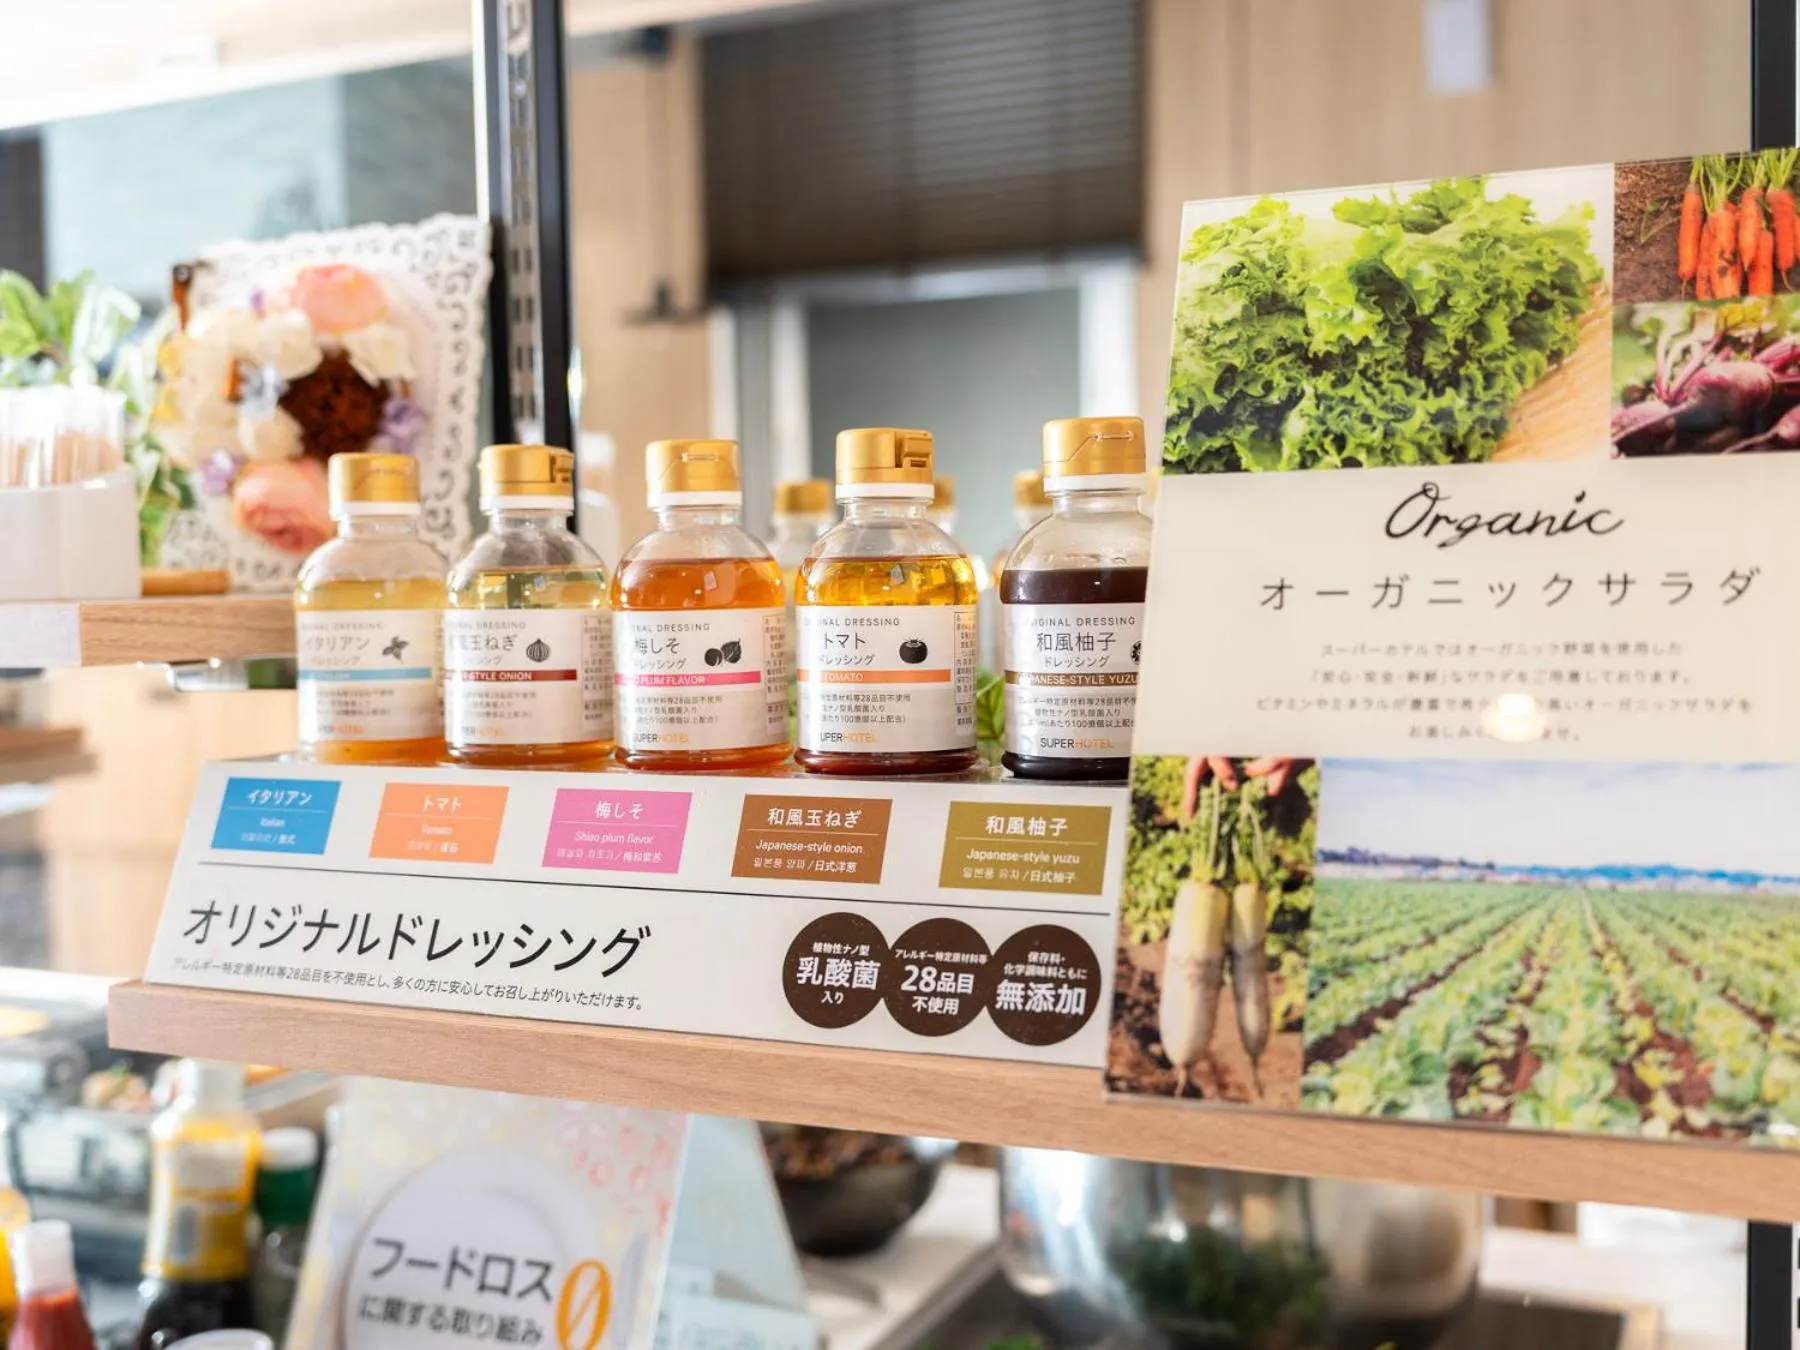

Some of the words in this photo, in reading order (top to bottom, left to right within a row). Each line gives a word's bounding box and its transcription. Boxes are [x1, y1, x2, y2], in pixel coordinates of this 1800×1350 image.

[1384, 482, 1625, 548] Organic
[1260, 566, 1761, 610] オーガニックサラダ
[657, 623, 710, 633] DRESSING
[845, 618, 900, 627] DRESSING
[1076, 616, 1136, 627] DRESSING
[635, 638, 680, 655] 梅しそ
[824, 632, 866, 650] トマト
[1037, 631, 1117, 652] 和風柚子
[1045, 655, 1110, 668] ドレッシング
[499, 671, 533, 681] ONION
[666, 675, 706, 686] FLAVOR
[824, 672, 864, 682] TOMATO
[820, 732, 875, 743] UPERHOTEL
[1040, 737, 1113, 749] SUPERHOTEL
[247, 788, 313, 806] イタリアン
[422, 795, 462, 812] トマト
[595, 800, 643, 819] 梅しそ
[767, 808, 862, 829] 和風玉ねぎ
[985, 815, 1068, 837] 和風柚子
[574, 831, 600, 843] Shiso
[600, 832, 625, 846] plum
[627, 832, 655, 845] flavor
[755, 839, 833, 855] Japanese-style
[834, 844, 864, 854] onion
[966, 849, 1051, 865] Japanese-style
[1052, 853, 1081, 865] yuzu
[183, 900, 652, 978] オリジナルドレッシング
[812, 941, 870, 957] 植物性ナノ型
[894, 949, 988, 965] アレルギー特定原材料等
[796, 957, 880, 990] 乳酸菌
[900, 965, 975, 994] 28品目
[1003, 963, 1088, 981] 化学調味料ともに
[821, 990, 844, 1004] 入り
[995, 978, 1087, 1016] 無添加
[912, 996, 959, 1016] 不使用
[370, 1236, 554, 1304] フードロス
[358, 1294, 544, 1346] に関する取り組み
